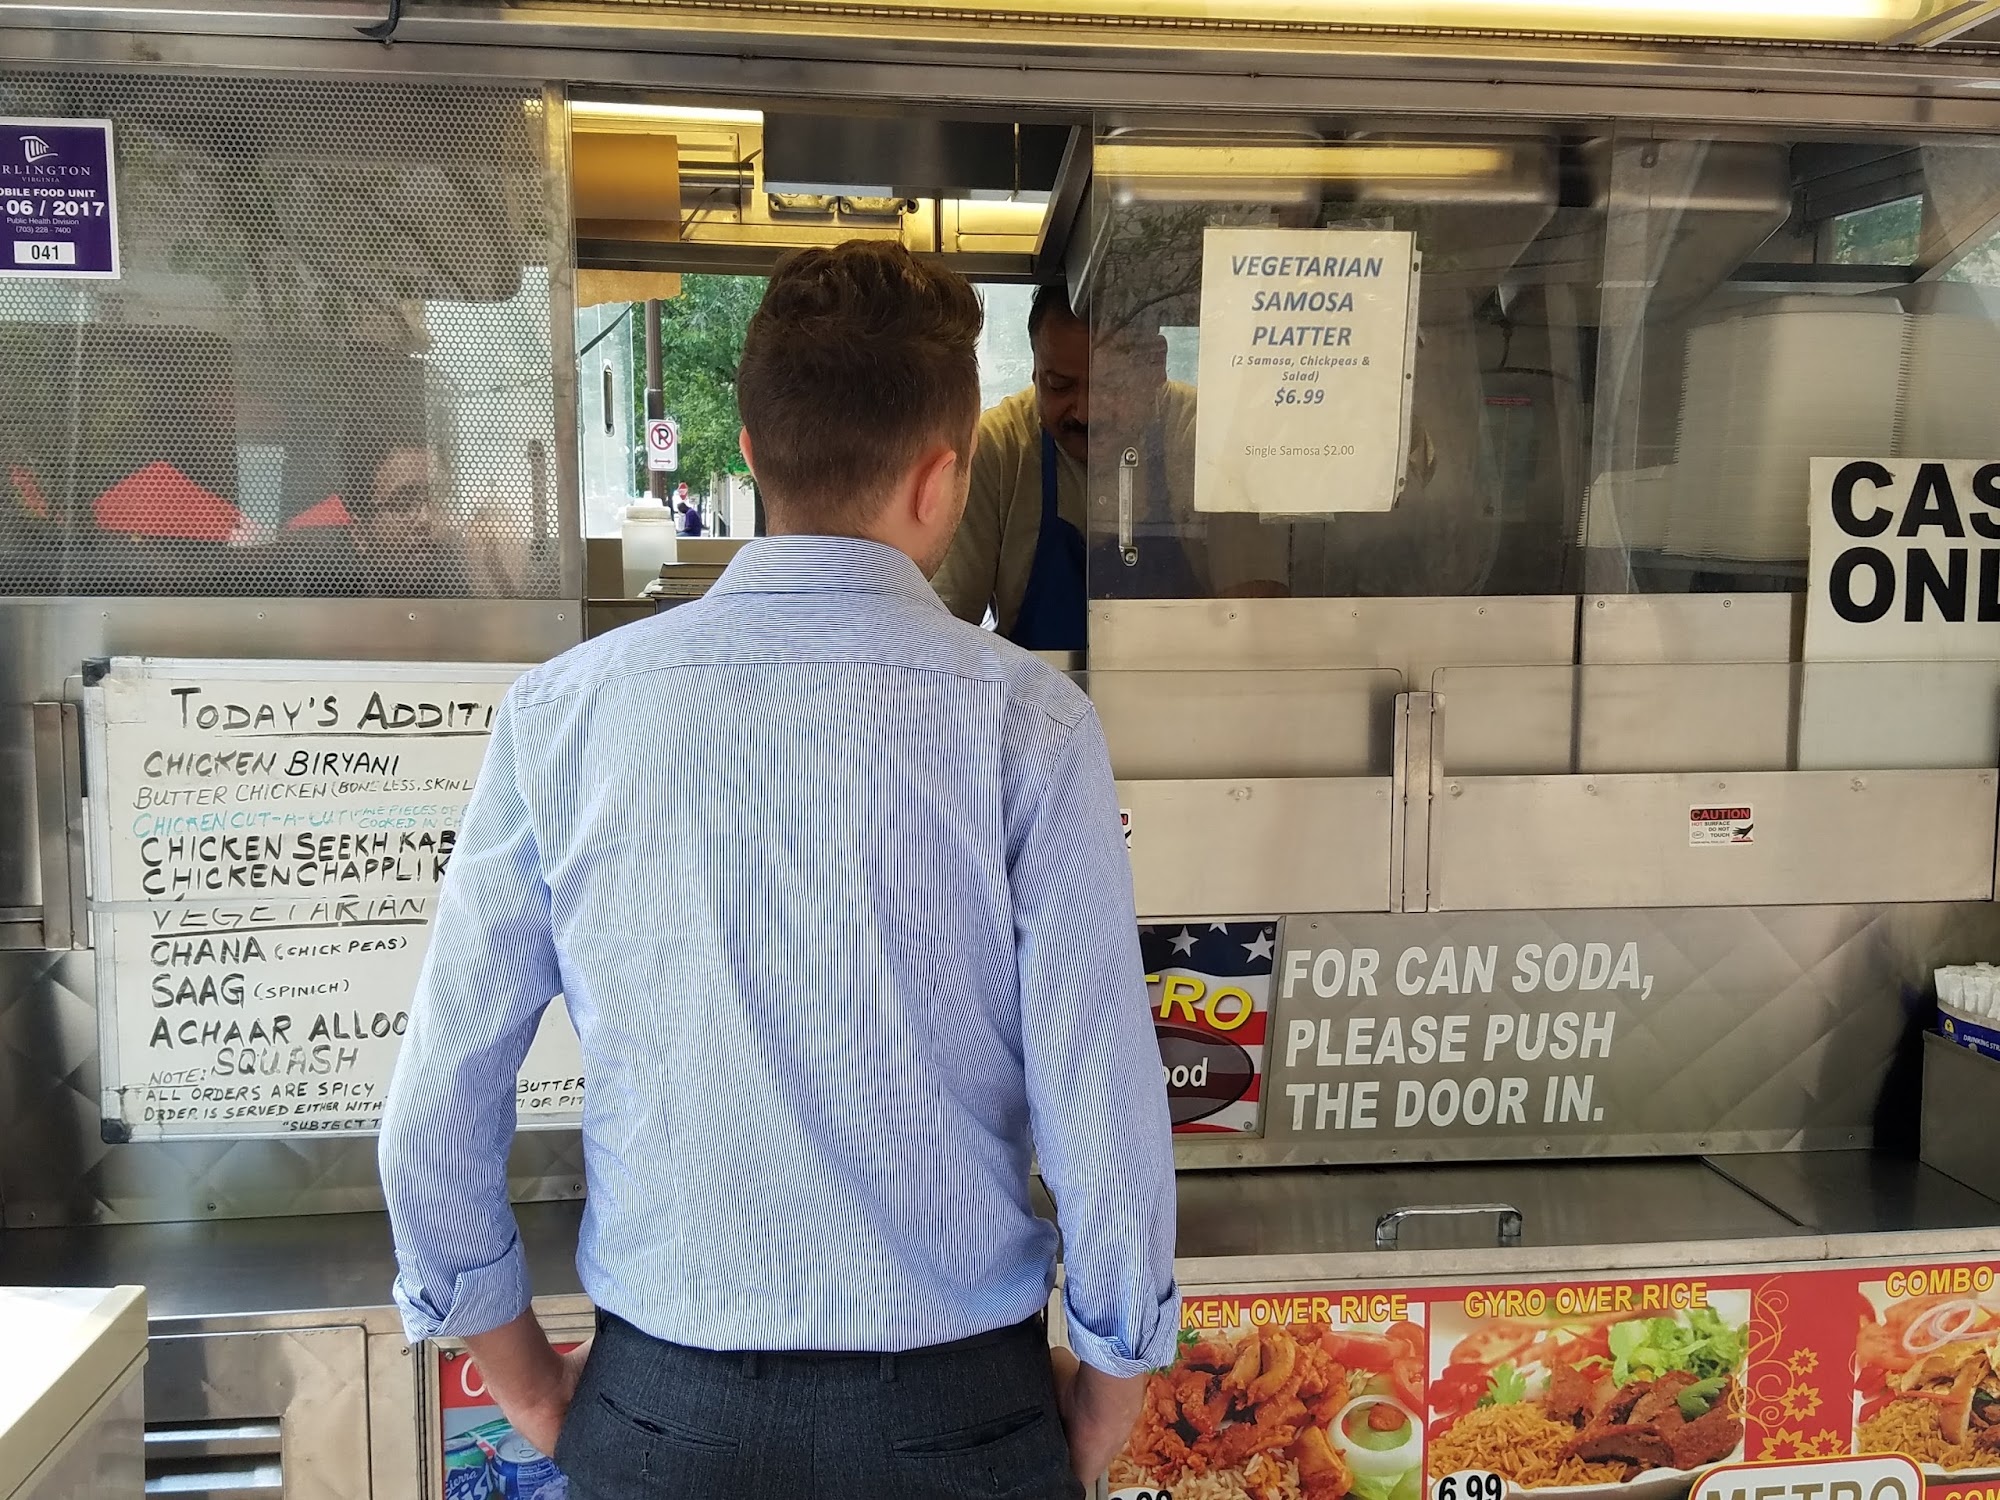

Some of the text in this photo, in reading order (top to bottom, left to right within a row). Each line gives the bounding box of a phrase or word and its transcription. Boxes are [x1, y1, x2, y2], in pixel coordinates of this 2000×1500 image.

[33, 188, 66, 197] FOOD
[68, 189, 96, 198] UNIT
[6, 217, 28, 225] Public
[28, 217, 52, 225] Health
[52, 200, 105, 217] 2017
[15, 225, 34, 235] (703)
[35, 226, 49, 234] 228
[54, 226, 72, 235] 7400
[31, 243, 60, 261] 041
[1231, 254, 1383, 278] VEGETARIAN
[1251, 291, 1354, 312] SAMOSA
[1251, 326, 1353, 347] PLATTER
[1231, 355, 1371, 369] (2 Samosa, Chickpeas &
[1281, 371, 1320, 384] Salad)
[1274, 386, 1326, 407] $6.99
[1245, 444, 1355, 459] Single Samosa $2.00
[1831, 460, 2000, 540] CAS
[356, 690, 497, 730] ADDITI
[143, 750, 401, 778] CHICKEN BIRYANI
[132, 786, 228, 810] BUTTER
[235, 782, 327, 802] CHICKEN
[422, 777, 475, 792] SKINL
[358, 816, 417, 829] COOKED
[1691, 807, 1750, 820] CAUTION
[140, 833, 282, 867] CHICKEN
[292, 831, 389, 862] SEEKH
[142, 863, 291, 895] CHICKEN
[296, 856, 422, 887] CHAPPLI
[150, 895, 427, 930] VEGETARIAN
[150, 936, 267, 968] CHANA
[347, 936, 408, 954] PEAS)
[1282, 941, 1654, 1001] FOR CAN SODA,
[151, 972, 351, 1009] SAAG (SPINICH)
[149, 1015, 292, 1050] ACHAAR
[1285, 1011, 1616, 1067] PLEASE PUSH
[1962, 1034, 1990, 1048] DRINKING
[210, 1044, 359, 1077] SQUASH
[149, 1067, 207, 1086] NOTE:
[145, 1088, 181, 1102] ALL
[191, 1084, 261, 1101] ORDERS
[270, 1081, 309, 1099] ARE
[317, 1081, 376, 1098] SPICY
[1285, 1074, 1605, 1131] THE DOOR IN.
[144, 1106, 198, 1122] ORDER
[203, 1107, 218, 1119] IS
[222, 1103, 289, 1118] SERVED
[293, 1101, 340, 1115] EITHER
[345, 1100, 383, 1112] WITH
[529, 1096, 553, 1109] OR
[1885, 1265, 1995, 1298] COMBO
[1181, 1293, 1409, 1329] KEN OVER RICE
[1463, 1281, 1709, 1319] GYRO OVER RICE
[1438, 1472, 1503, 1500] 699
